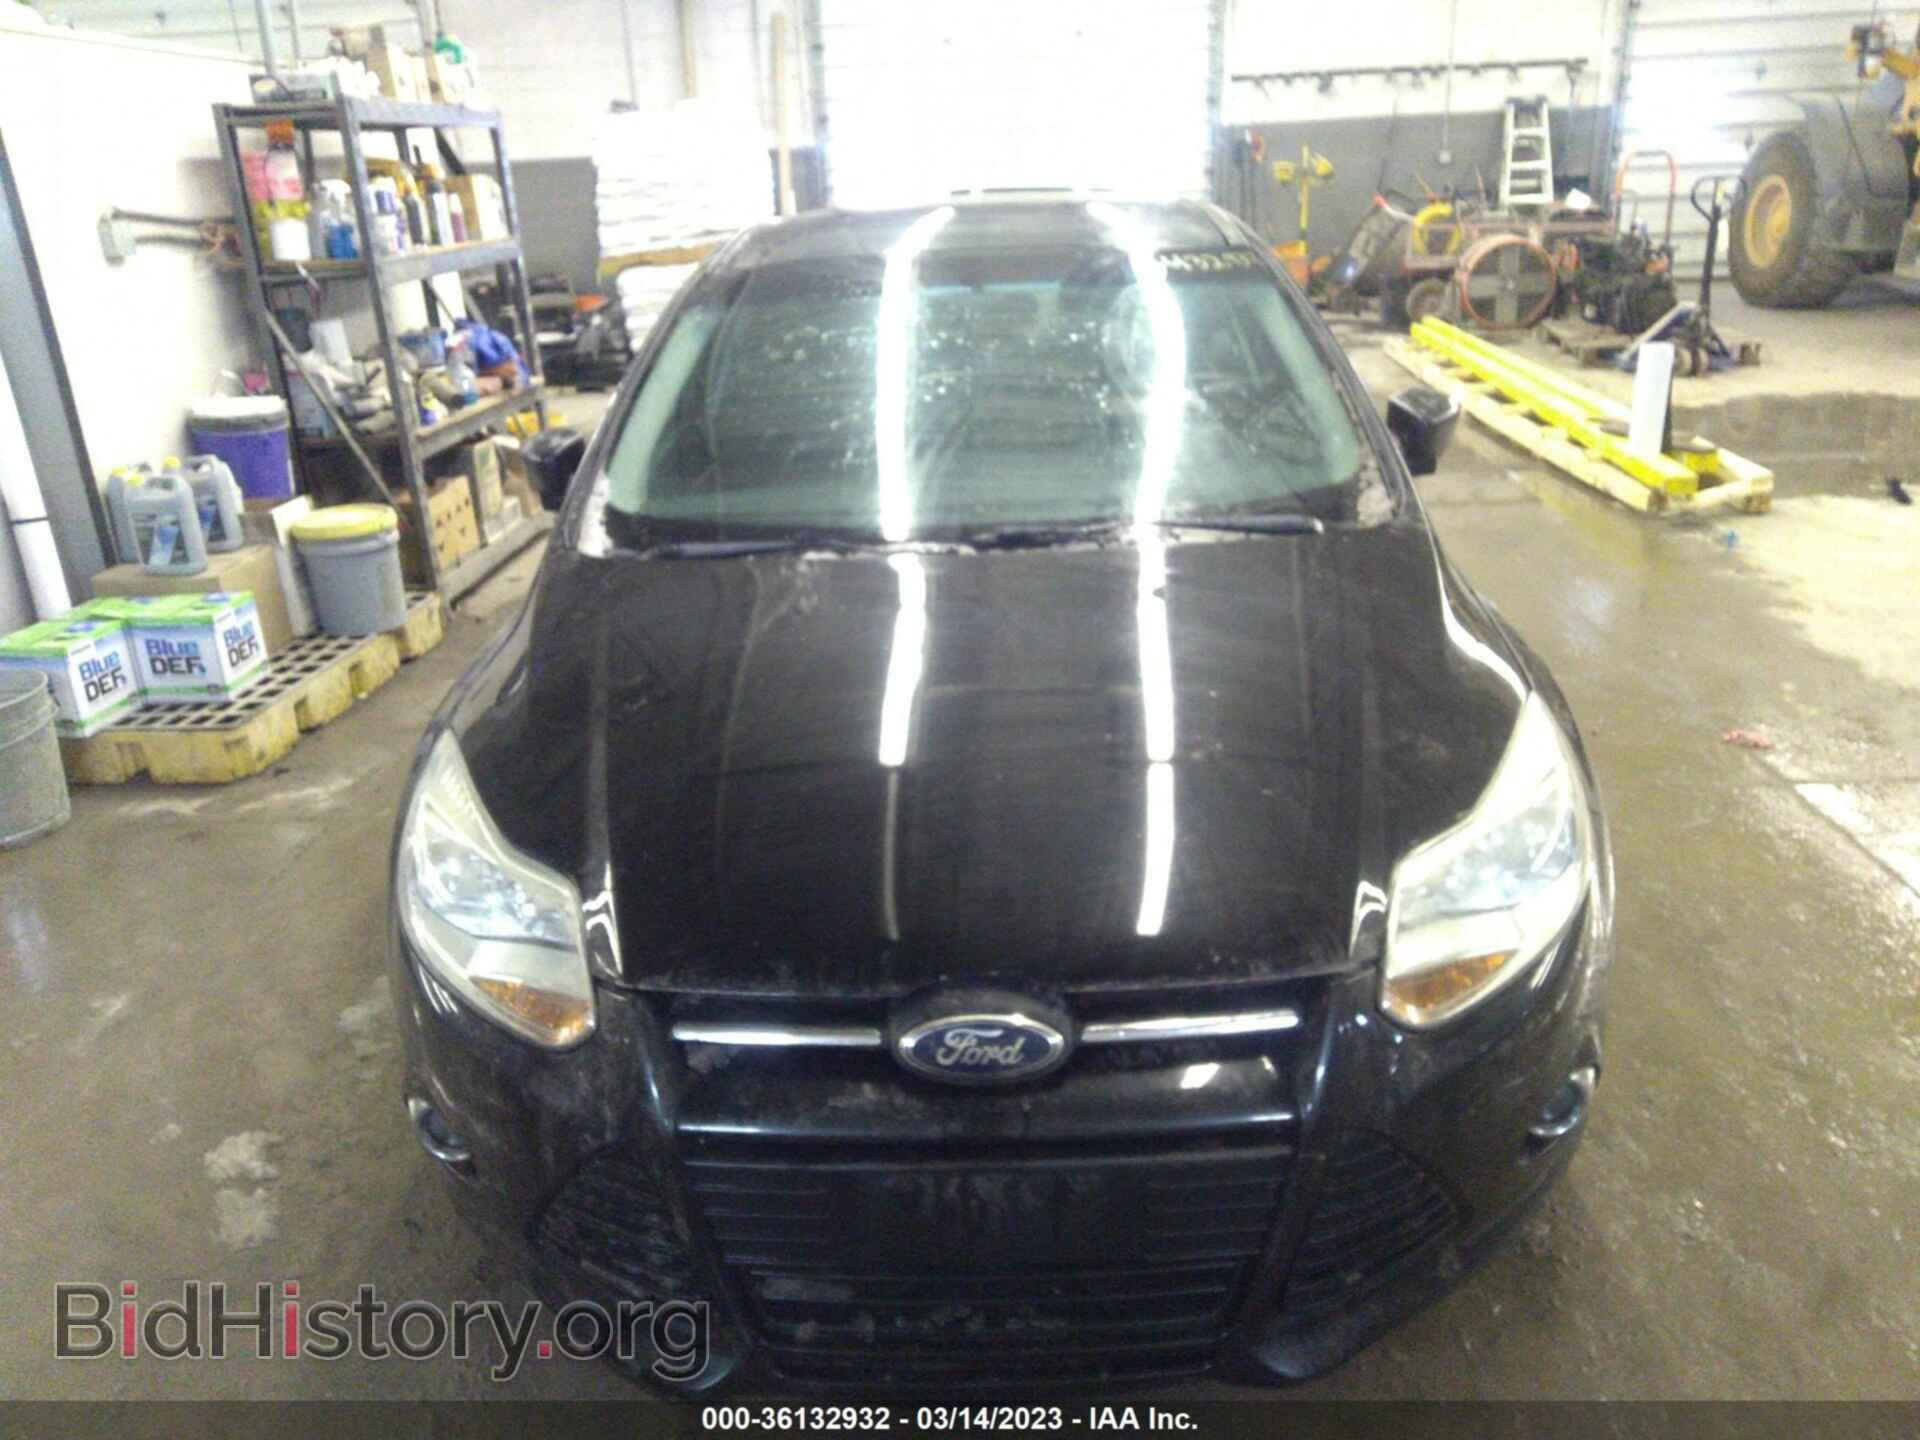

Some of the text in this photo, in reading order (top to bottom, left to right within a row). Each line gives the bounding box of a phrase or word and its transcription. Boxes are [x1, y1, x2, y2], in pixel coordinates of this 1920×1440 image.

[145, 639, 197, 656] Blue
[228, 636, 258, 667] DEF
[79, 652, 119, 681] Blue
[151, 657, 206, 675] DEF
[84, 668, 127, 701] DEF
[936, 1028, 1027, 1066] Ford
